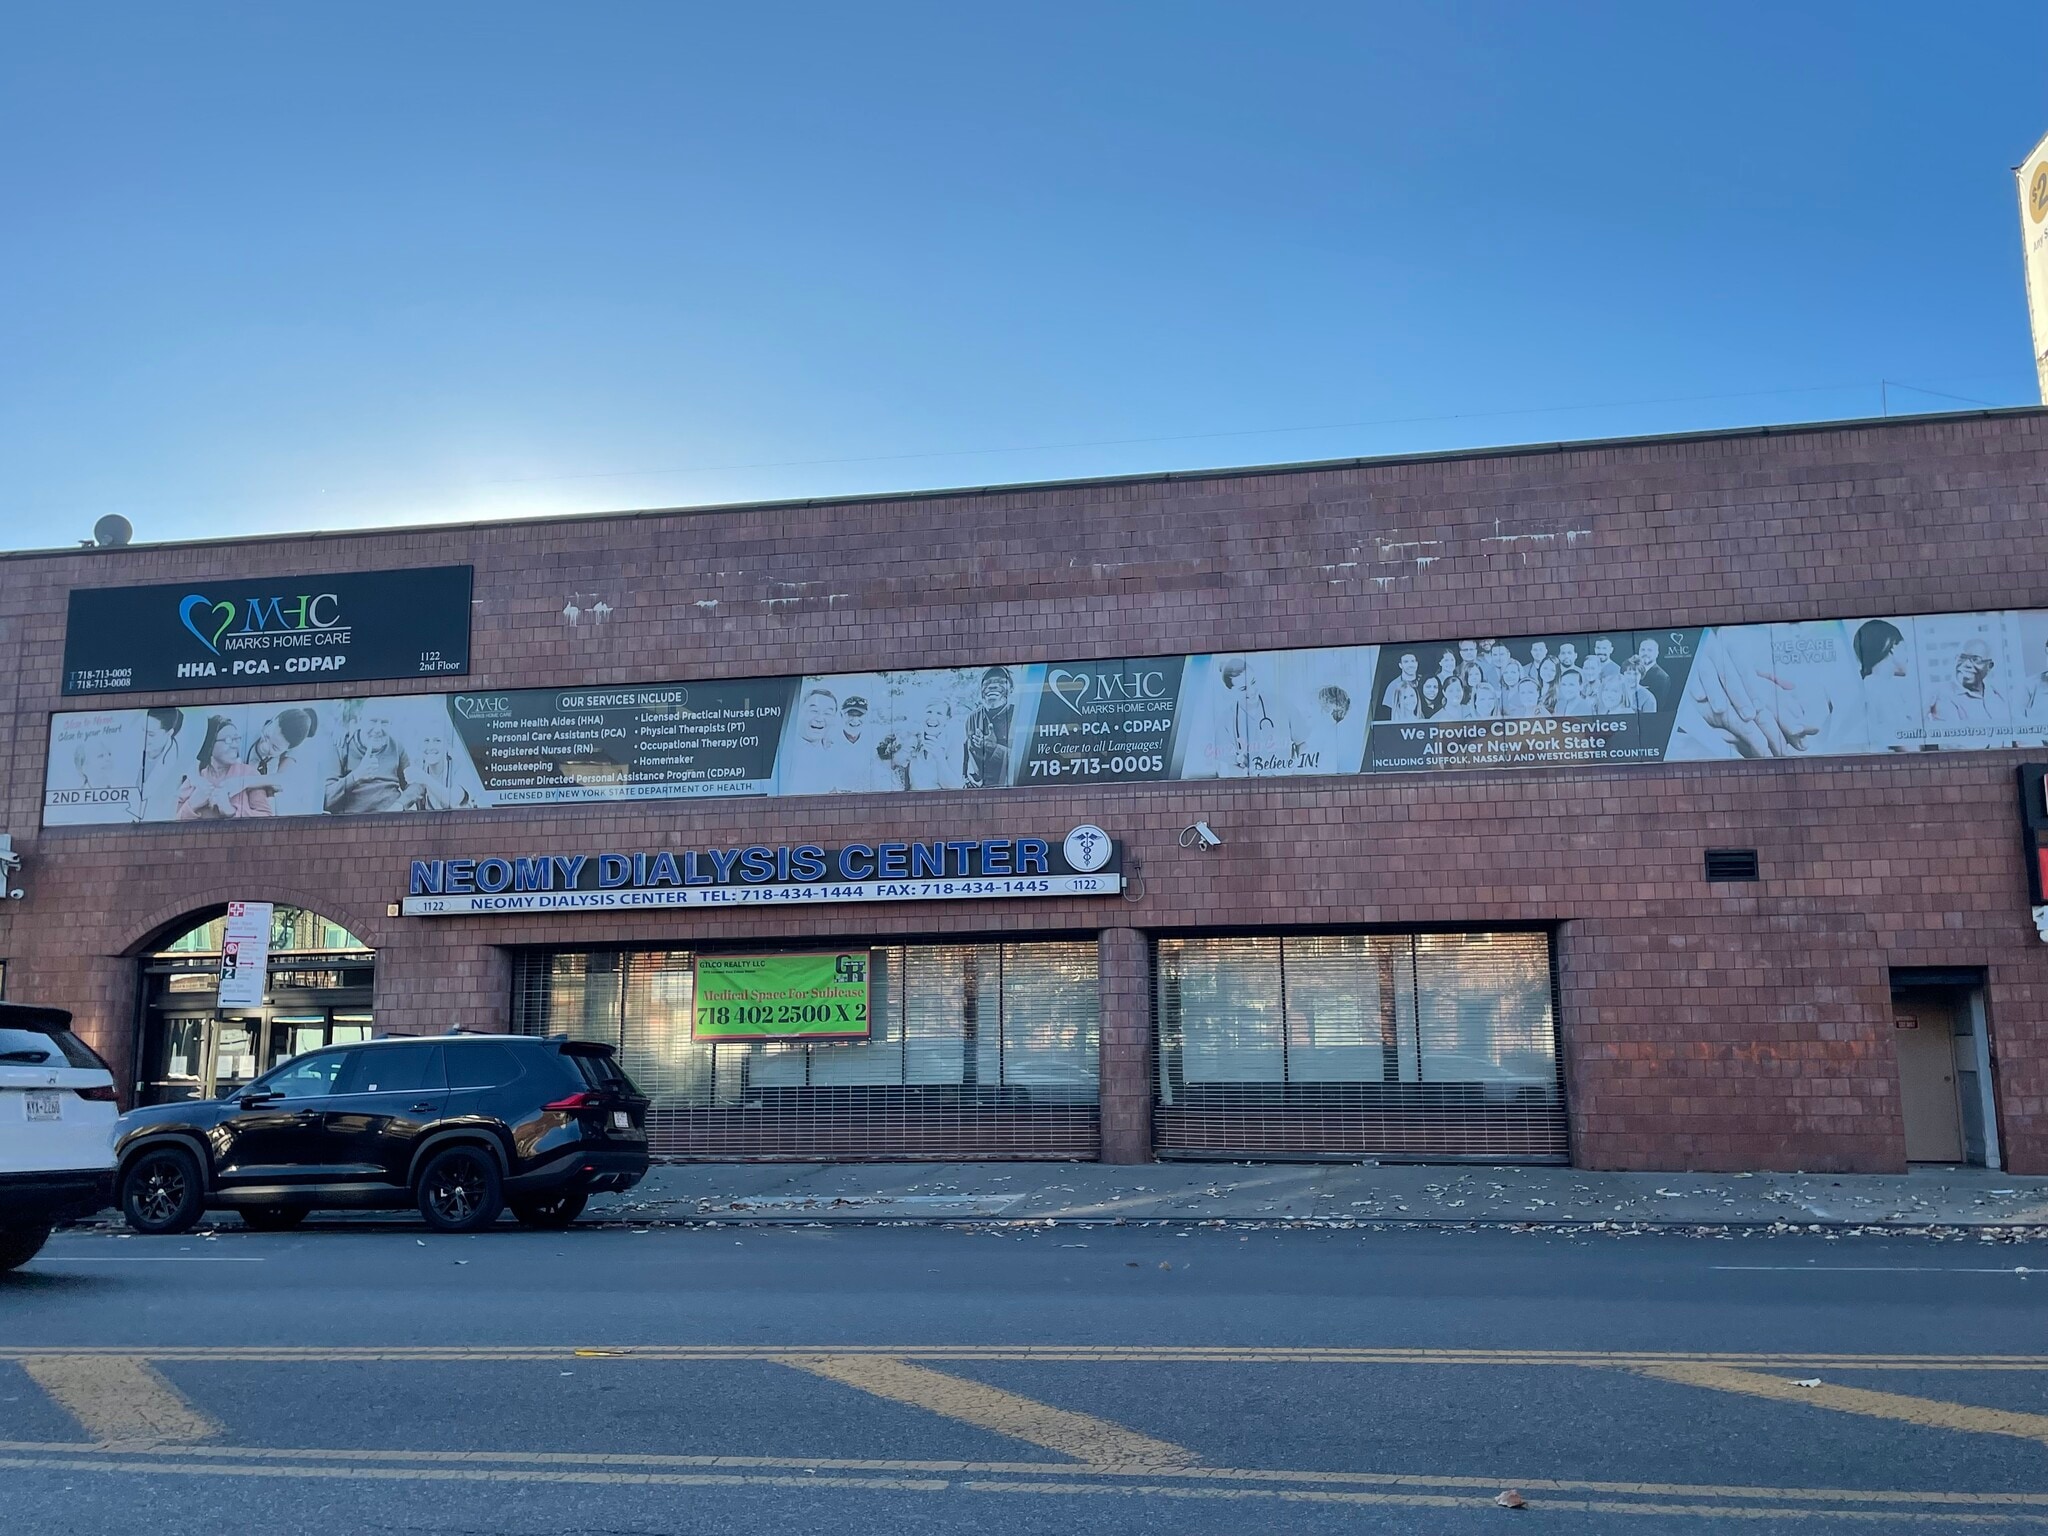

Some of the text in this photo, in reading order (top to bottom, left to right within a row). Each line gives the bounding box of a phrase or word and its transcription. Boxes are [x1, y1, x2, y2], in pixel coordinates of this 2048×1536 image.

[244, 594, 341, 631] MHC
[224, 631, 351, 651] MARKS HOME CARE
[1771, 638, 1833, 653] WE CARE
[419, 650, 440, 661] 1122
[1774, 653, 1801, 665] FOR
[77, 667, 132, 680] 718-713-0005
[178, 655, 346, 678] HHA PCA CDPAP
[419, 659, 460, 671] 2nd Floor
[76, 677, 131, 690] 718-713-0008
[1096, 671, 1166, 700] MHC
[476, 697, 509, 711] MHC
[562, 692, 682, 708] OUR SERVICES INCLUDE
[1081, 701, 1174, 715] MARKS HOME CARE
[493, 714, 604, 729] Home Health Aides (HHA)
[640, 706, 781, 723] Licensed Practical Nurses (LPN)
[492, 727, 627, 743] Personal Care Assistants (PCA)
[640, 721, 746, 738] Physical Therapists (PT)
[1039, 718, 1172, 738] HHA PCA CDPAP
[1400, 719, 1628, 740] We Provide CDPAP Services
[491, 743, 594, 759] Registered Nurses (RN)
[640, 735, 759, 752] Occupational Therapy (OT)
[1037, 738, 1163, 754] We Cater to all Languages!
[1423, 736, 1606, 755] All Over New York State
[639, 754, 694, 766] Homemaker
[1252, 752, 1320, 771] Believe IN!
[1372, 747, 1660, 768] INCLUDING SUFFOLK, NASSAU AND WESTCHESTER COUNTIES
[490, 761, 553, 775] Housekeeping
[1030, 755, 1163, 778] 718-713-0005
[490, 766, 746, 788] Consumer Directed Personal Assistance Program (CDPAP)
[52, 788, 129, 804] 2ND FLOOR
[499, 790, 543, 801] LICENSED
[544, 789, 557, 799] BY
[557, 788, 579, 798] NEW
[581, 787, 606, 797] YORK
[608, 786, 635, 796] STATE
[638, 784, 700, 795] DEPARTMENT
[702, 783, 714, 792] OF
[410, 838, 1050, 894] NEOMY DIALYSIS CENTER
[422, 879, 1098, 912] 1122 NEOMY DIALYSIS CENTER TEL: 718-434-1444 FAX: 718-434-1445 1122
[724, 960, 751, 968] REALTY
[703, 986, 864, 1003] Medical Space For Sublease
[697, 1003, 867, 1025] 718 402 2500 X 2
